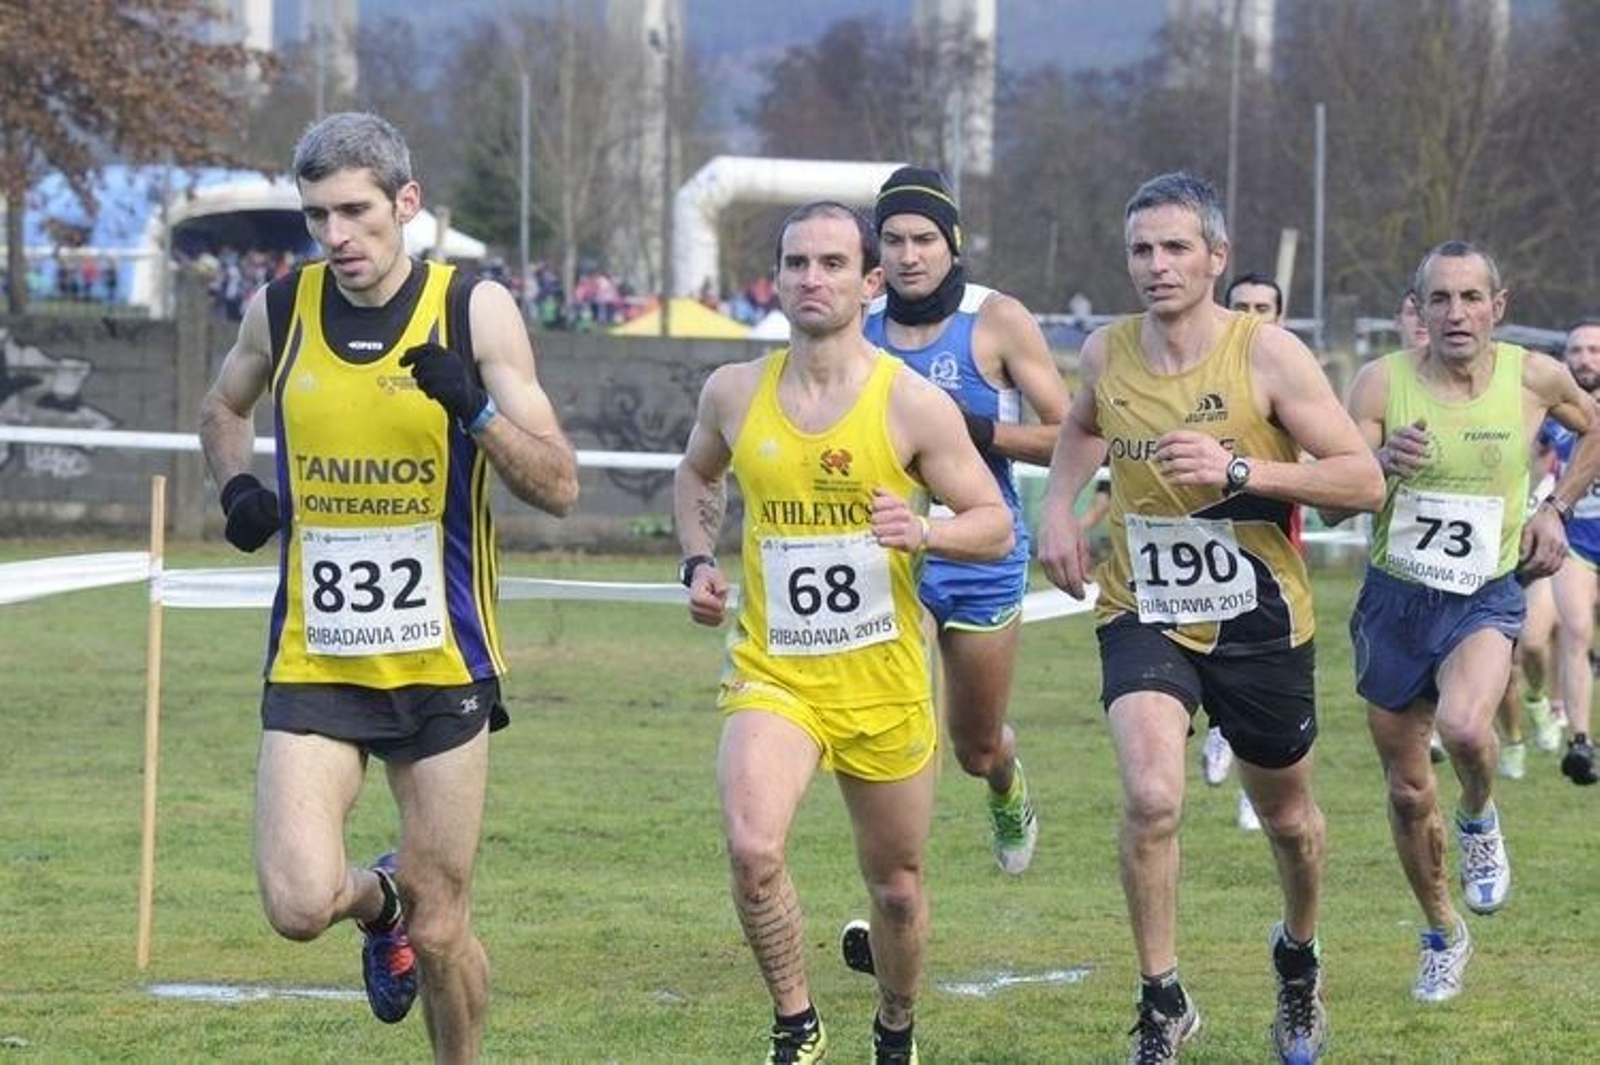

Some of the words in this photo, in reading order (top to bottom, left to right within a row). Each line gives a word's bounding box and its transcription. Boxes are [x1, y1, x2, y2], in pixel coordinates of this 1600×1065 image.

[296, 455, 435, 484] TANINOS
[1415, 516, 1473, 558] 73
[1140, 540, 1238, 586] 190
[312, 558, 426, 613] 832
[788, 564, 861, 616] 68
[1459, 571, 1488, 588] 201
[1140, 597, 1214, 615] RIBADAVIA
[1219, 592, 1254, 611] 2015
[308, 626, 394, 646] RIBADAVIA
[402, 620, 441, 640] 2015
[769, 628, 850, 646] RIBADAVIA
[855, 616, 892, 638] 2015
